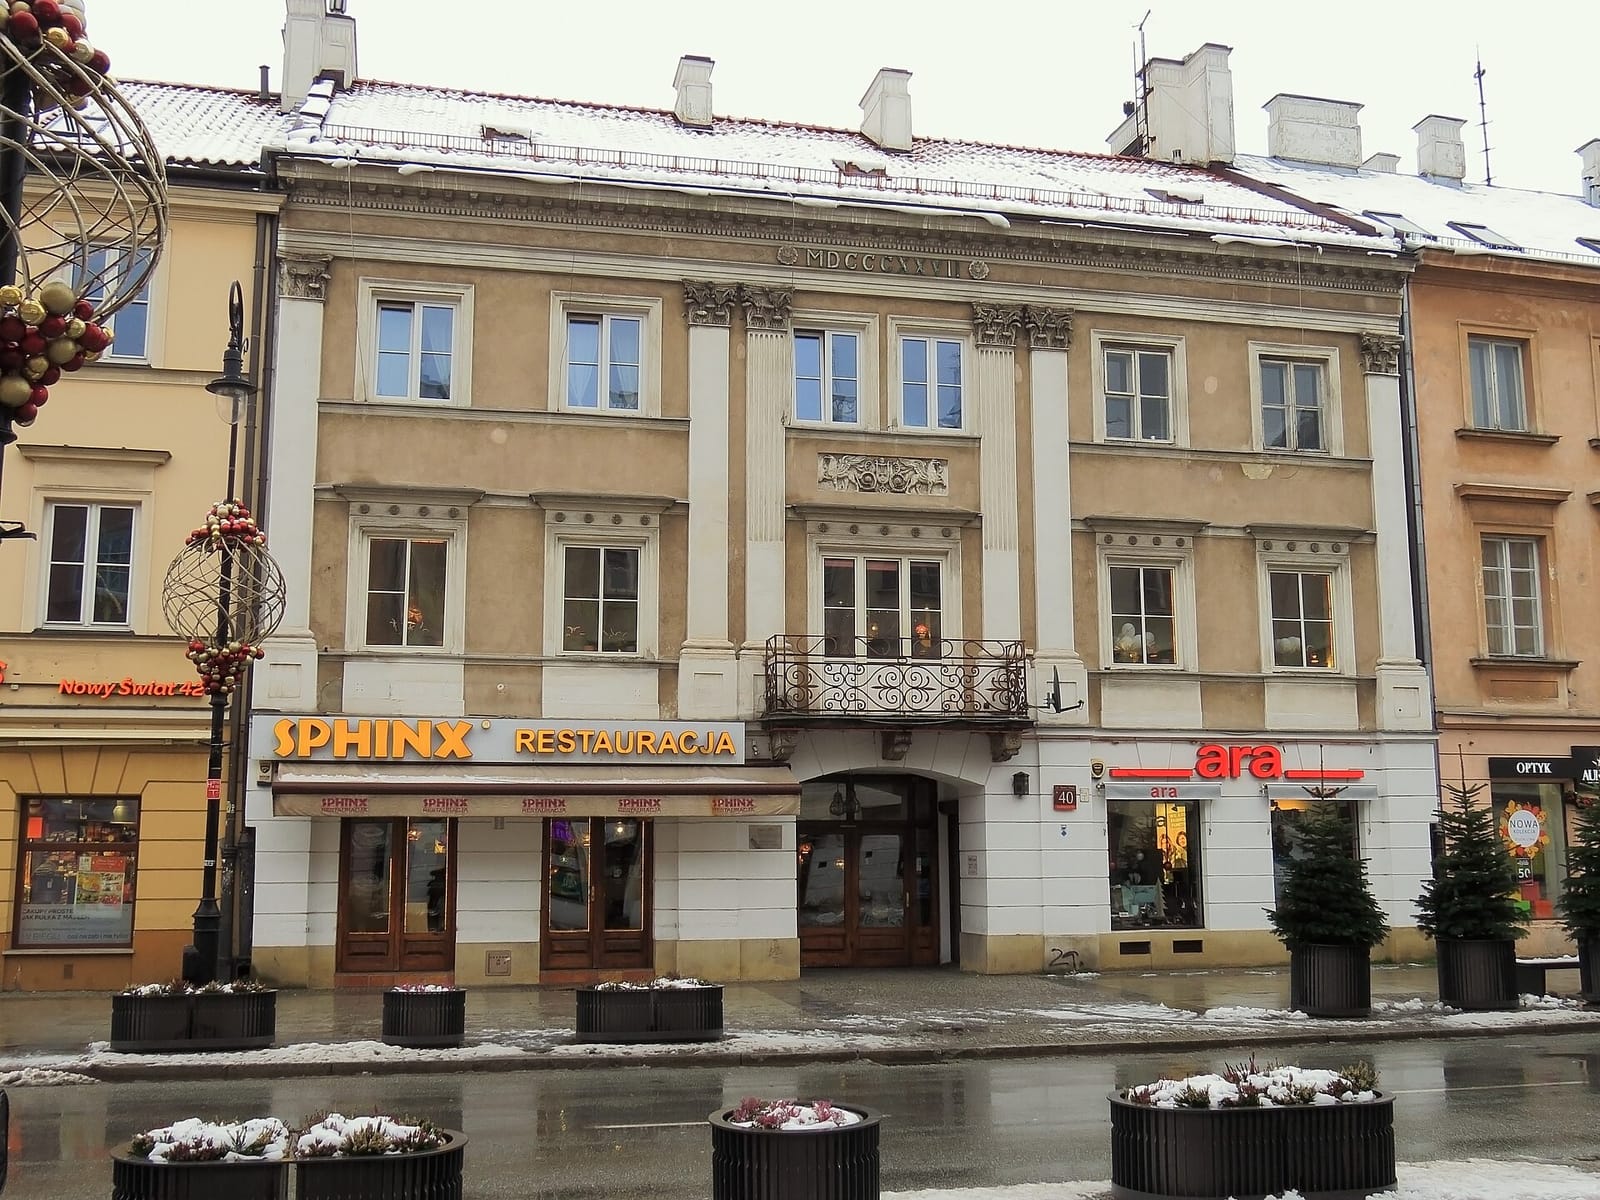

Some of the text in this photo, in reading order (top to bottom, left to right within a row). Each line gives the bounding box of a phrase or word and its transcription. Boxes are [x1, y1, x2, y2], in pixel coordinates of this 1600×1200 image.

[58, 676, 206, 699] Nowy Świat 42
[272, 718, 737, 760] SPHINX RESTAURACJA
[1196, 743, 1283, 780] ara
[1516, 762, 1552, 774] OPTYK
[1150, 785, 1178, 798] ara
[322, 798, 369, 807] SPHINX
[423, 798, 468, 807] SPHINX
[522, 798, 566, 807] SPHINX
[619, 798, 661, 807] SPHINX
[712, 798, 754, 807] SPHINX
[1058, 791, 1074, 805] 40
[1509, 820, 1538, 829] NOWA
